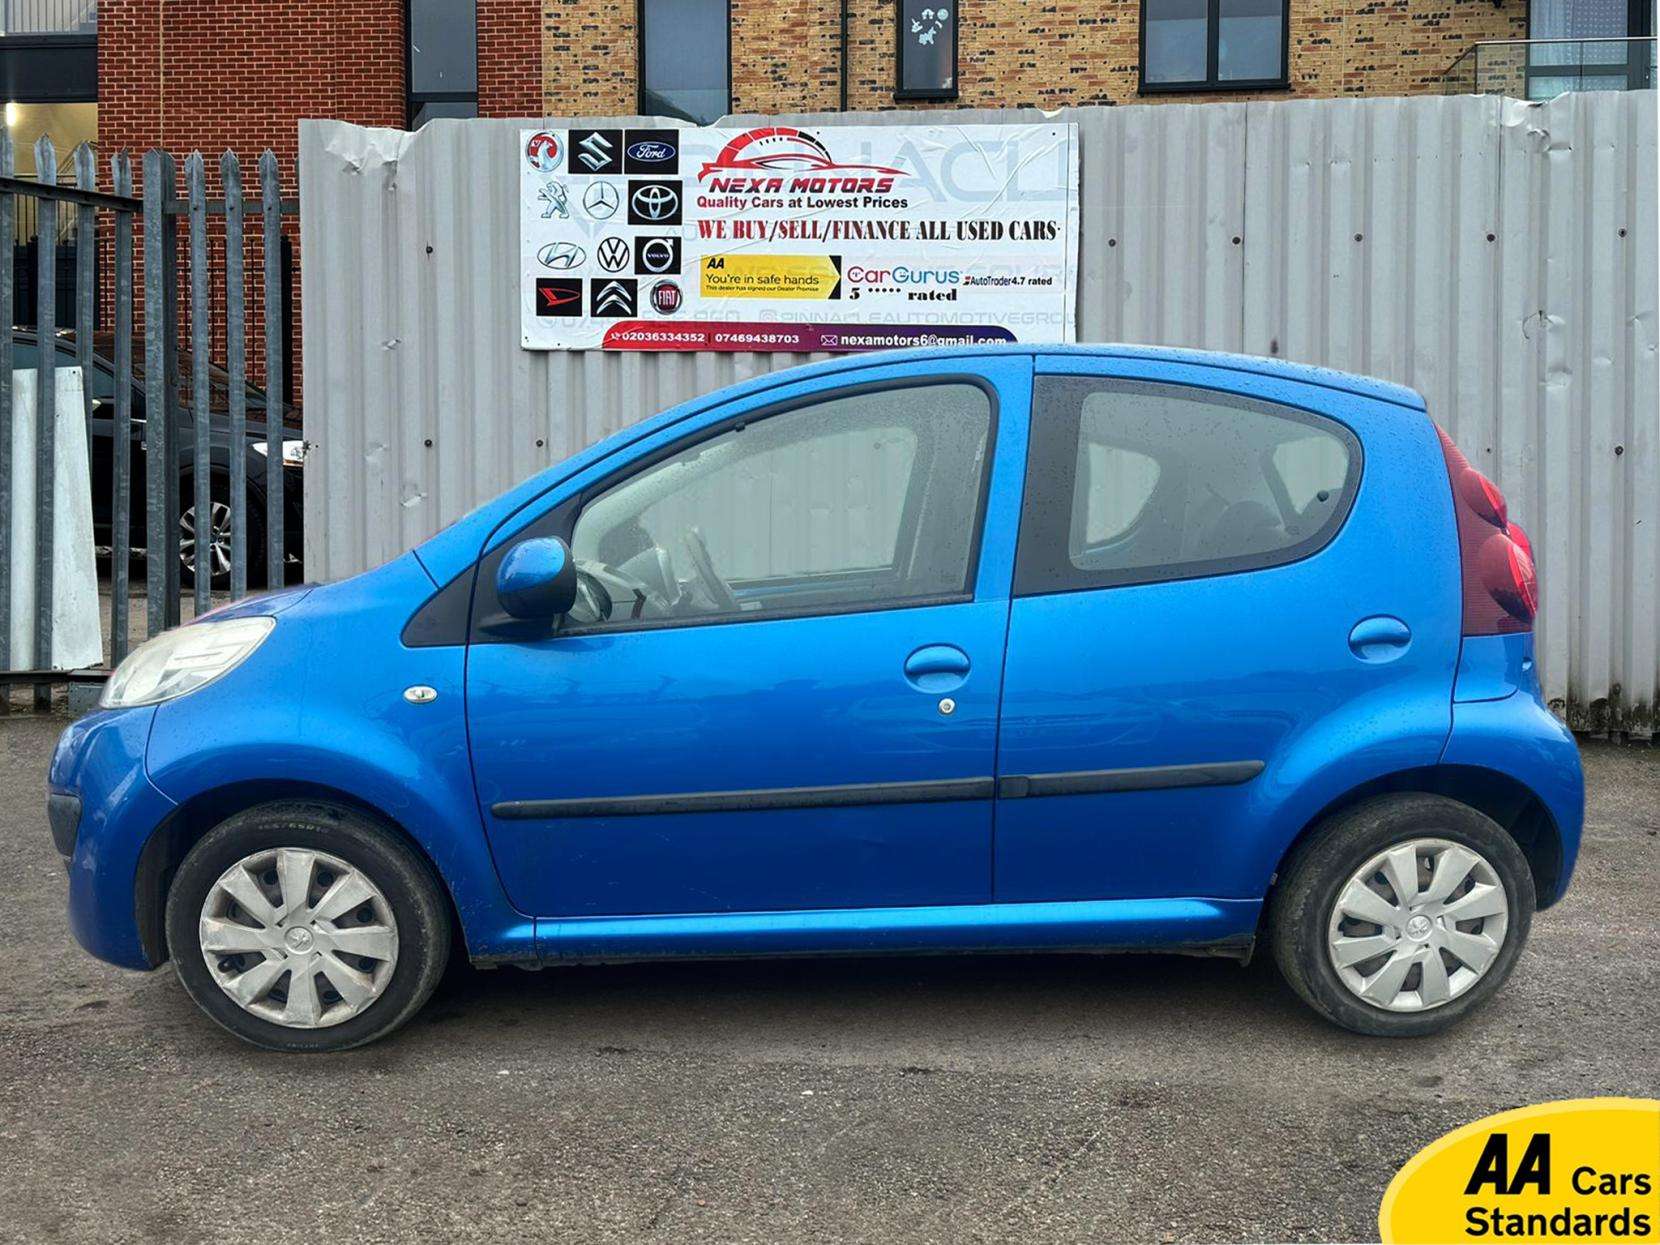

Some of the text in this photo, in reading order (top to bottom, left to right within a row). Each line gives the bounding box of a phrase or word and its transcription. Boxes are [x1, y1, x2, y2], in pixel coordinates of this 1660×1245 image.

[636, 144, 667, 159] Ford
[709, 177, 895, 193] NEXA MOTORS
[697, 196, 908, 210] Quality Cars at Lowest Prices
[697, 220, 726, 240] WE
[917, 220, 950, 240] ALL
[956, 220, 1003, 240] USED
[1009, 220, 1056, 240] CARS
[707, 258, 725, 269] AA
[706, 274, 819, 285] You're in safe hands
[847, 266, 959, 284] CarGurus
[1028, 277, 1053, 285] rated
[658, 290, 676, 306] FIAT
[849, 287, 957, 301] 5 rated
[622, 332, 705, 342] 02036334352
